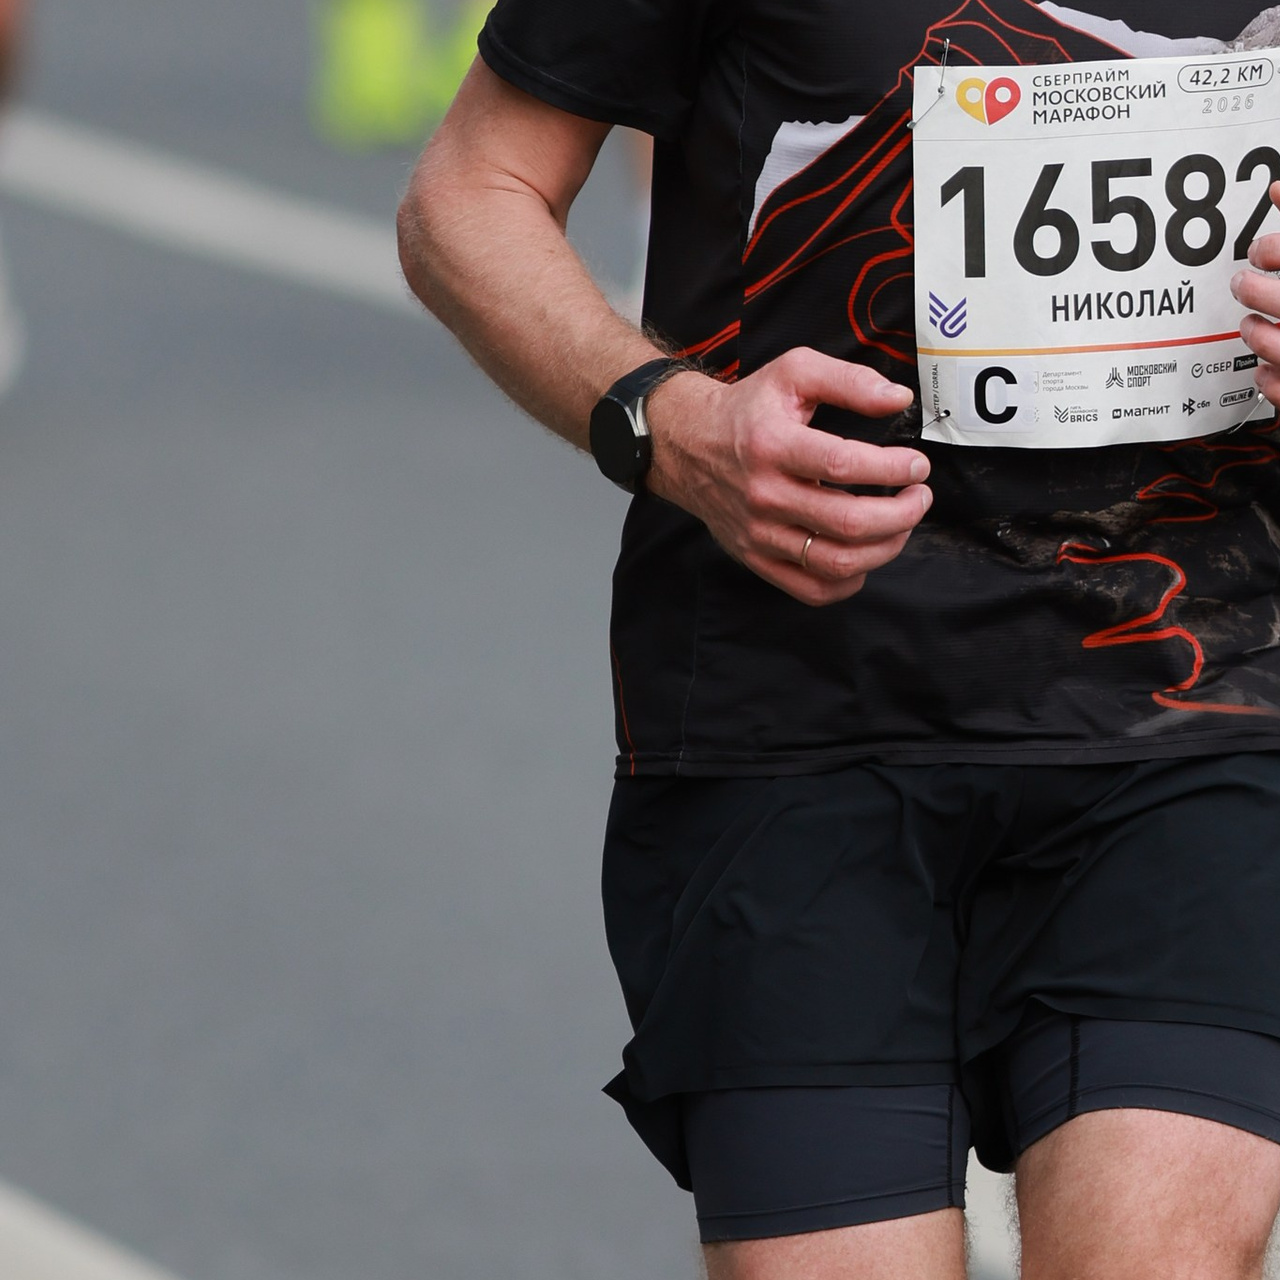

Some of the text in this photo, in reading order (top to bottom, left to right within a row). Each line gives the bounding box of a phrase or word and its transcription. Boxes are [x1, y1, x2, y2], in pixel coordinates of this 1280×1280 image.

[1032, 68, 1130, 88] СБЕРПРАЙМ
[1189, 64, 1264, 87] 42,2 КМ
[1032, 80, 1167, 106] МОСКОВСКИЙ
[1201, 93, 1256, 114] 2026
[1032, 104, 1131, 125] МАРАФОН
[1051, 281, 1195, 322] НИКОЛАЙ
[931, 363, 939, 389] CORRAL
[1127, 360, 1177, 376] МОСКОВСКИЙ
[1206, 361, 1232, 374] СБЕР
[1070, 413, 1099, 423] BRICS
